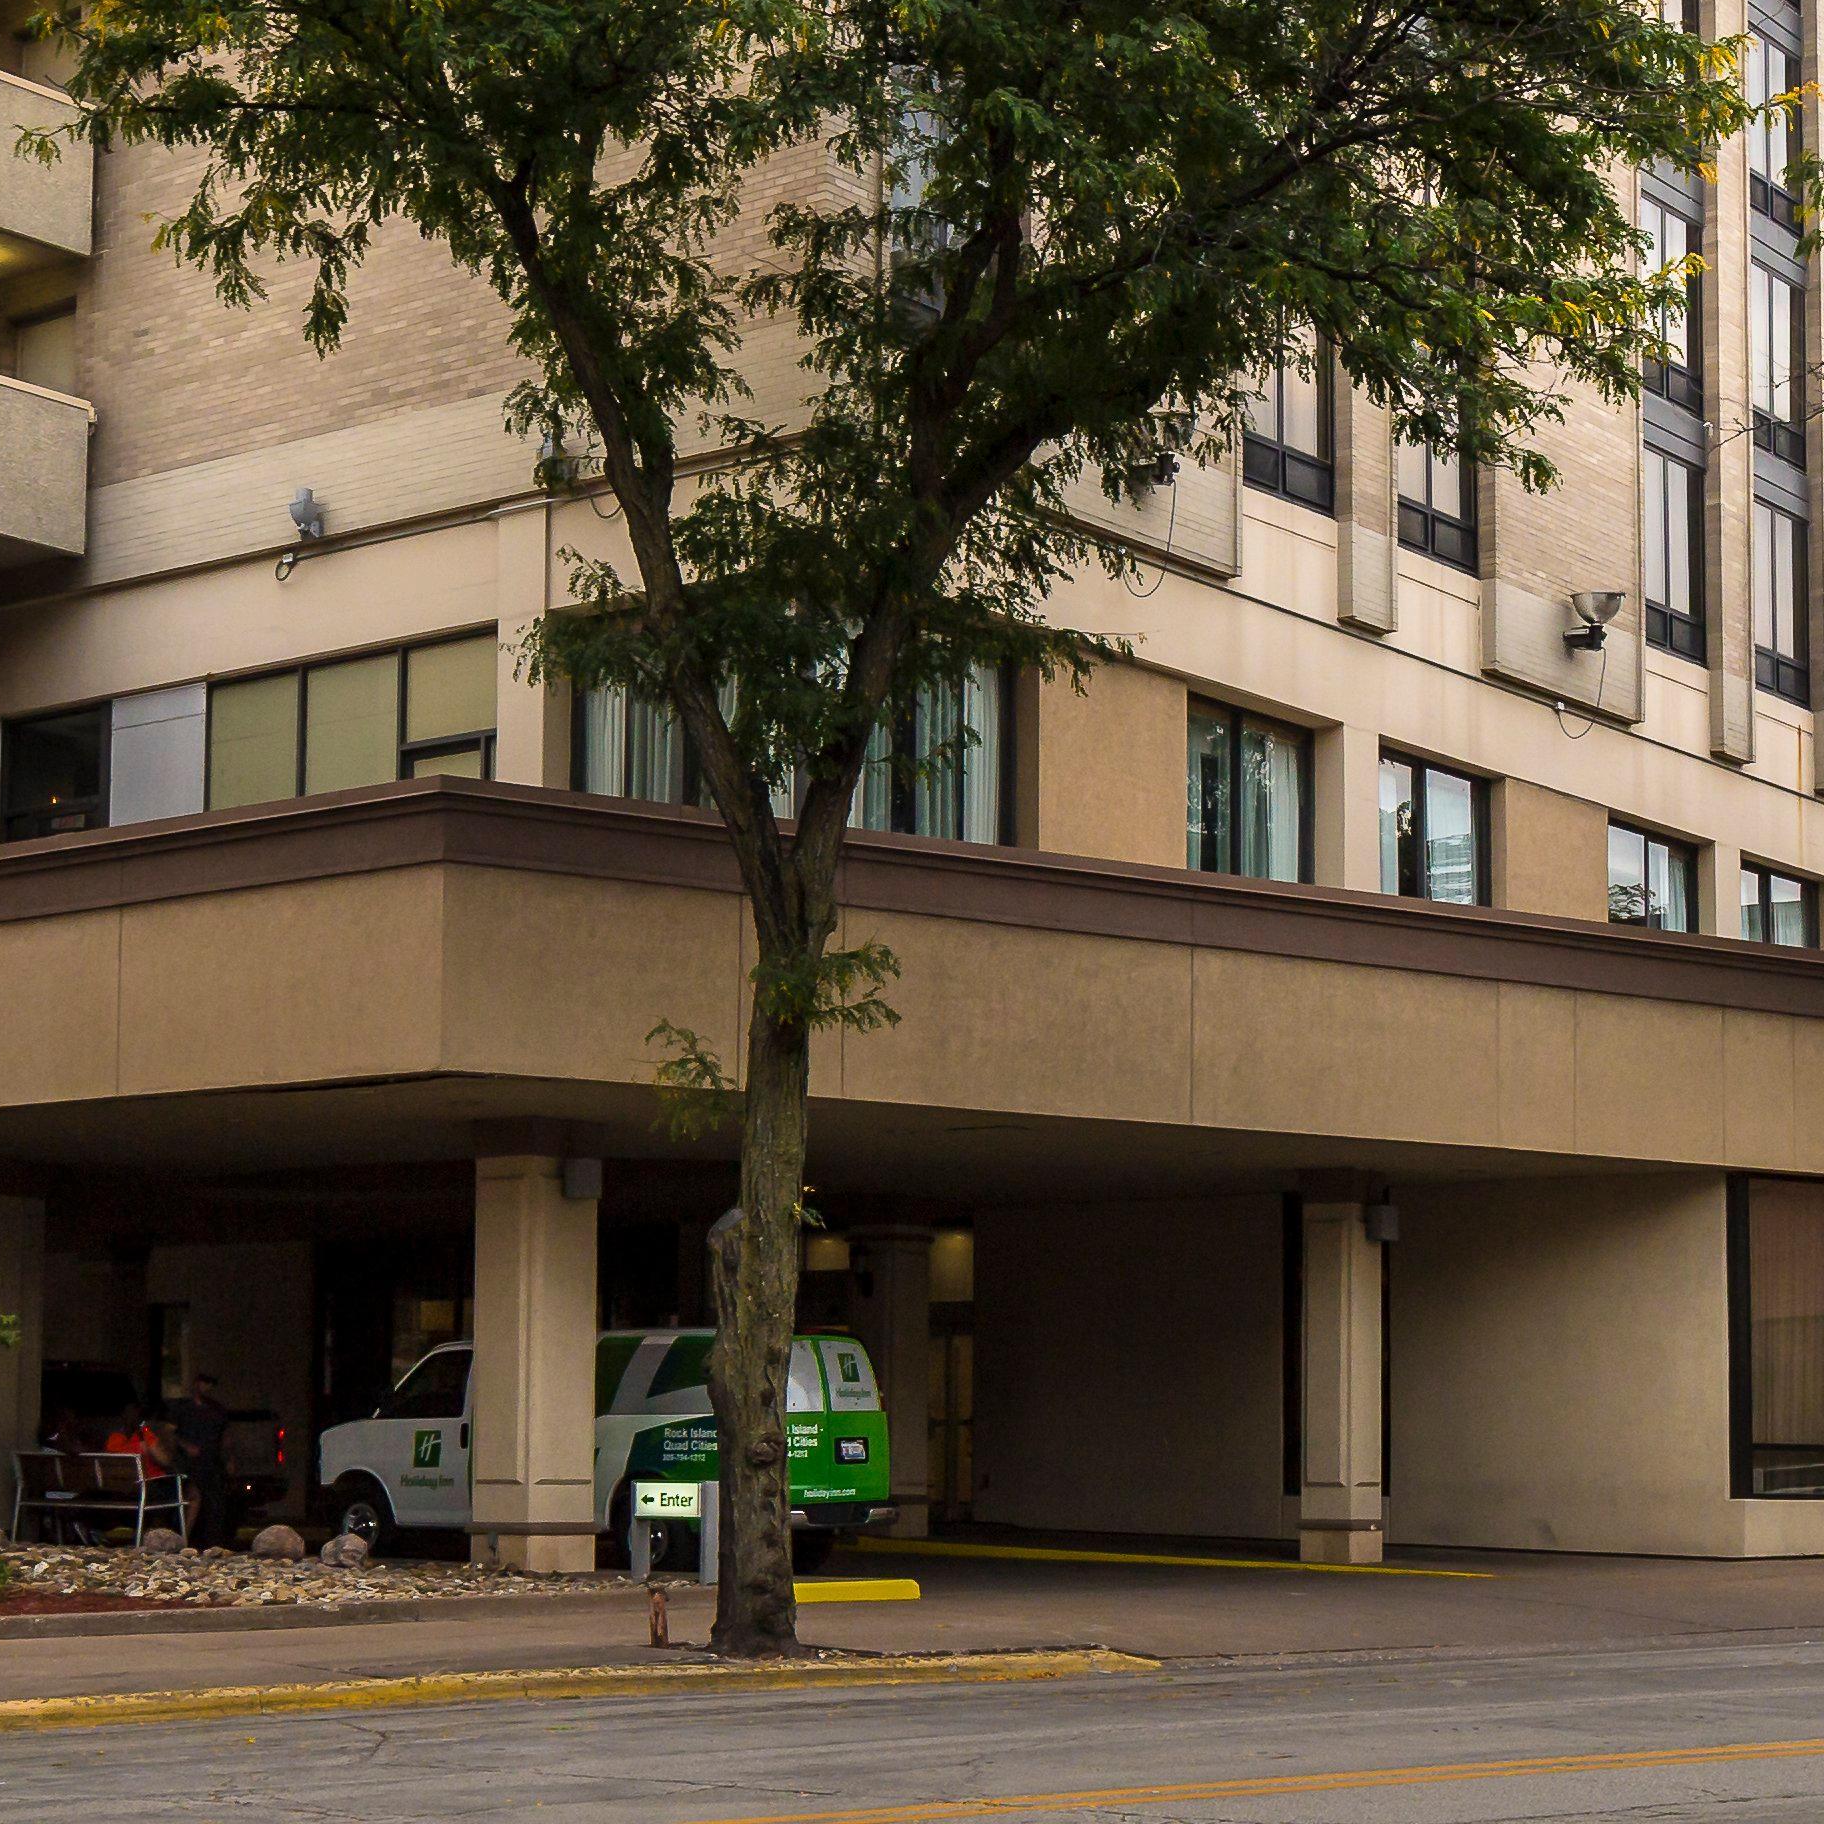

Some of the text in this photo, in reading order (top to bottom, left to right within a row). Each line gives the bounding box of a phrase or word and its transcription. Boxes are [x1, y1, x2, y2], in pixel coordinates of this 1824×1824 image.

[664, 1427, 688, 1438] Rock
[791, 1423, 818, 1435] Island
[663, 1439, 718, 1451] Quad Cities
[792, 1436, 818, 1447] Cities
[659, 1492, 694, 1507] Enter
